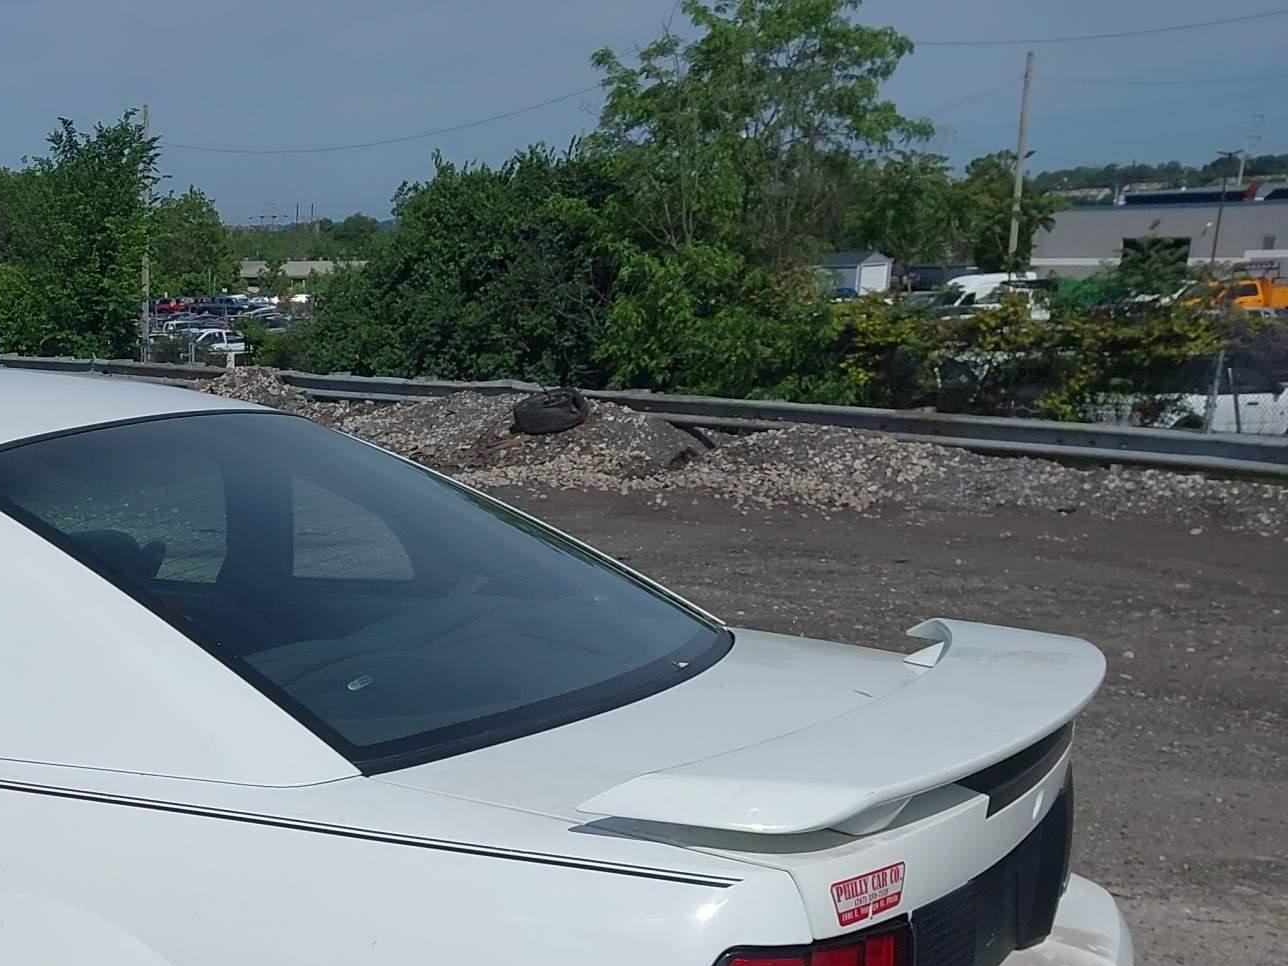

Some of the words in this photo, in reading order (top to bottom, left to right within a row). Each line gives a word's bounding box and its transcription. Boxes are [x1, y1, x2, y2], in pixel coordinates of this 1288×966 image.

[835, 878, 868, 902] PHILLY
[871, 872, 888, 890] CAR
[890, 866, 903, 884] CO.
